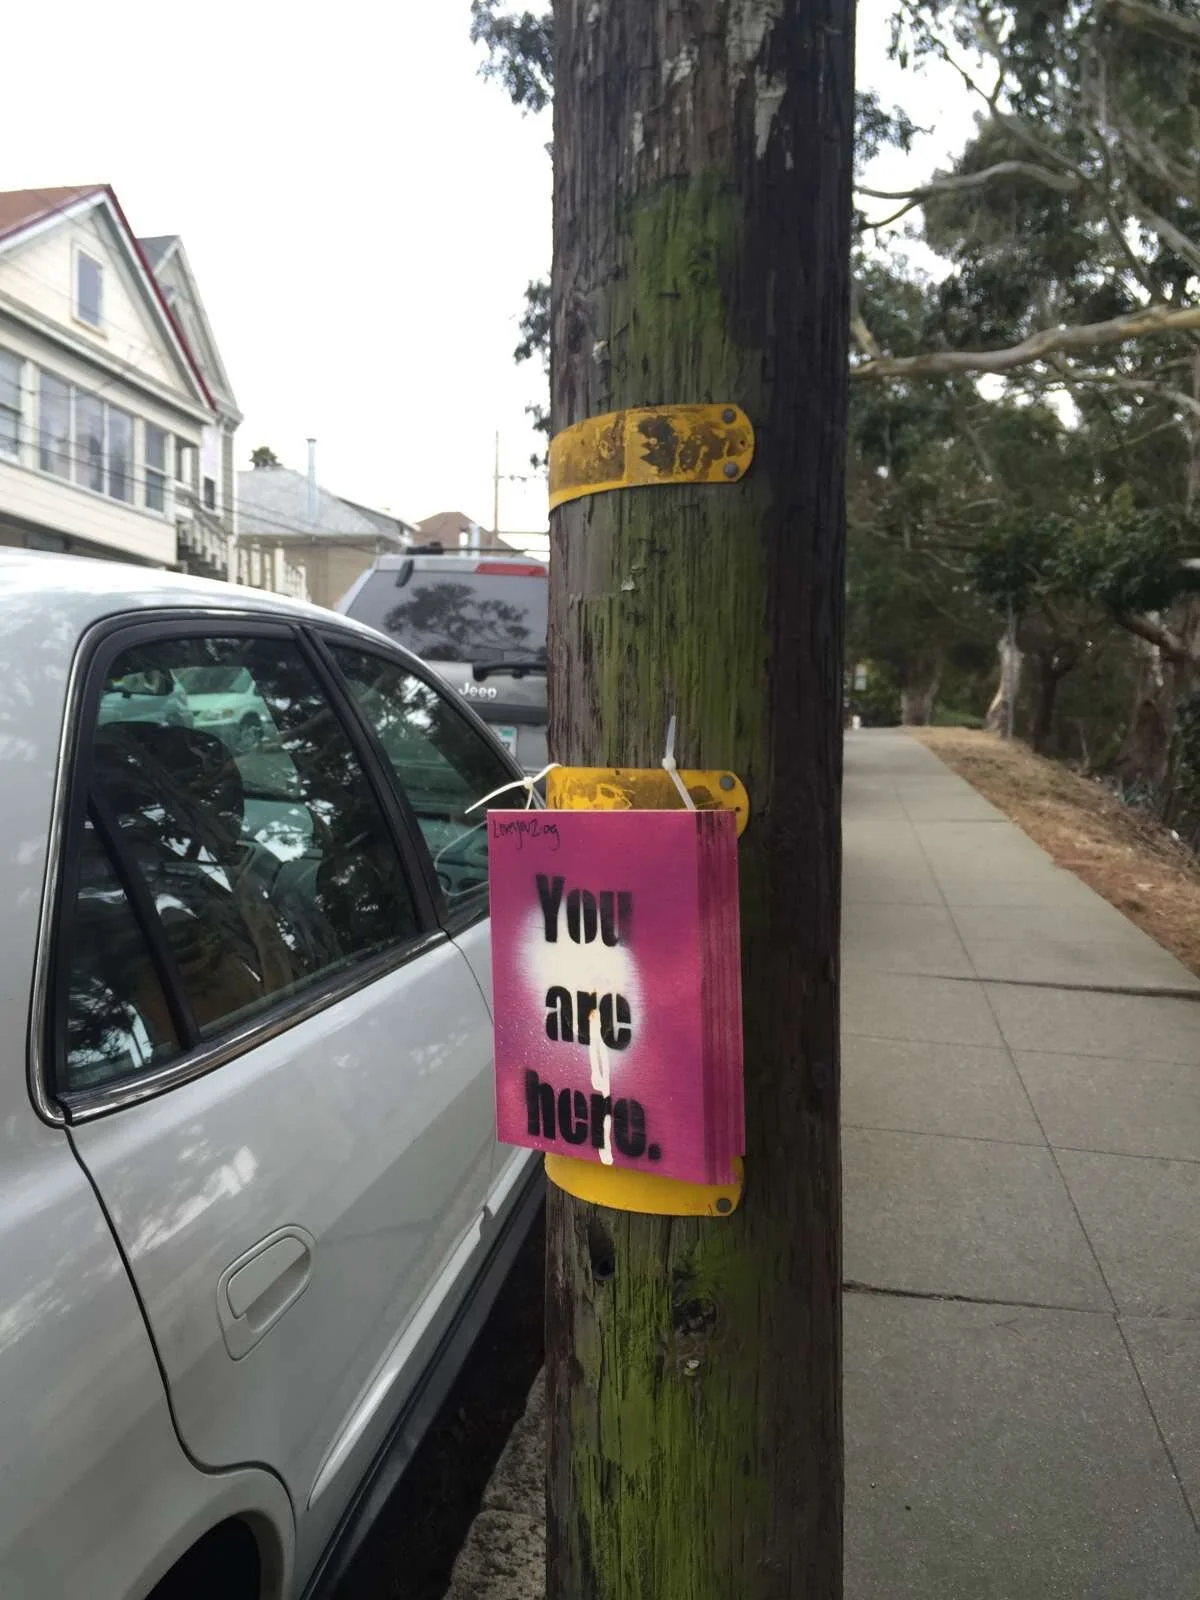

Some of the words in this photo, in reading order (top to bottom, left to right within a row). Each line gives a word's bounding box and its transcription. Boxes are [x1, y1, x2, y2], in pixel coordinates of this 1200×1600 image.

[457, 682, 497, 698] Jeep
[535, 874, 634, 946] You
[545, 984, 632, 1050] are
[525, 1069, 662, 1161] here.
